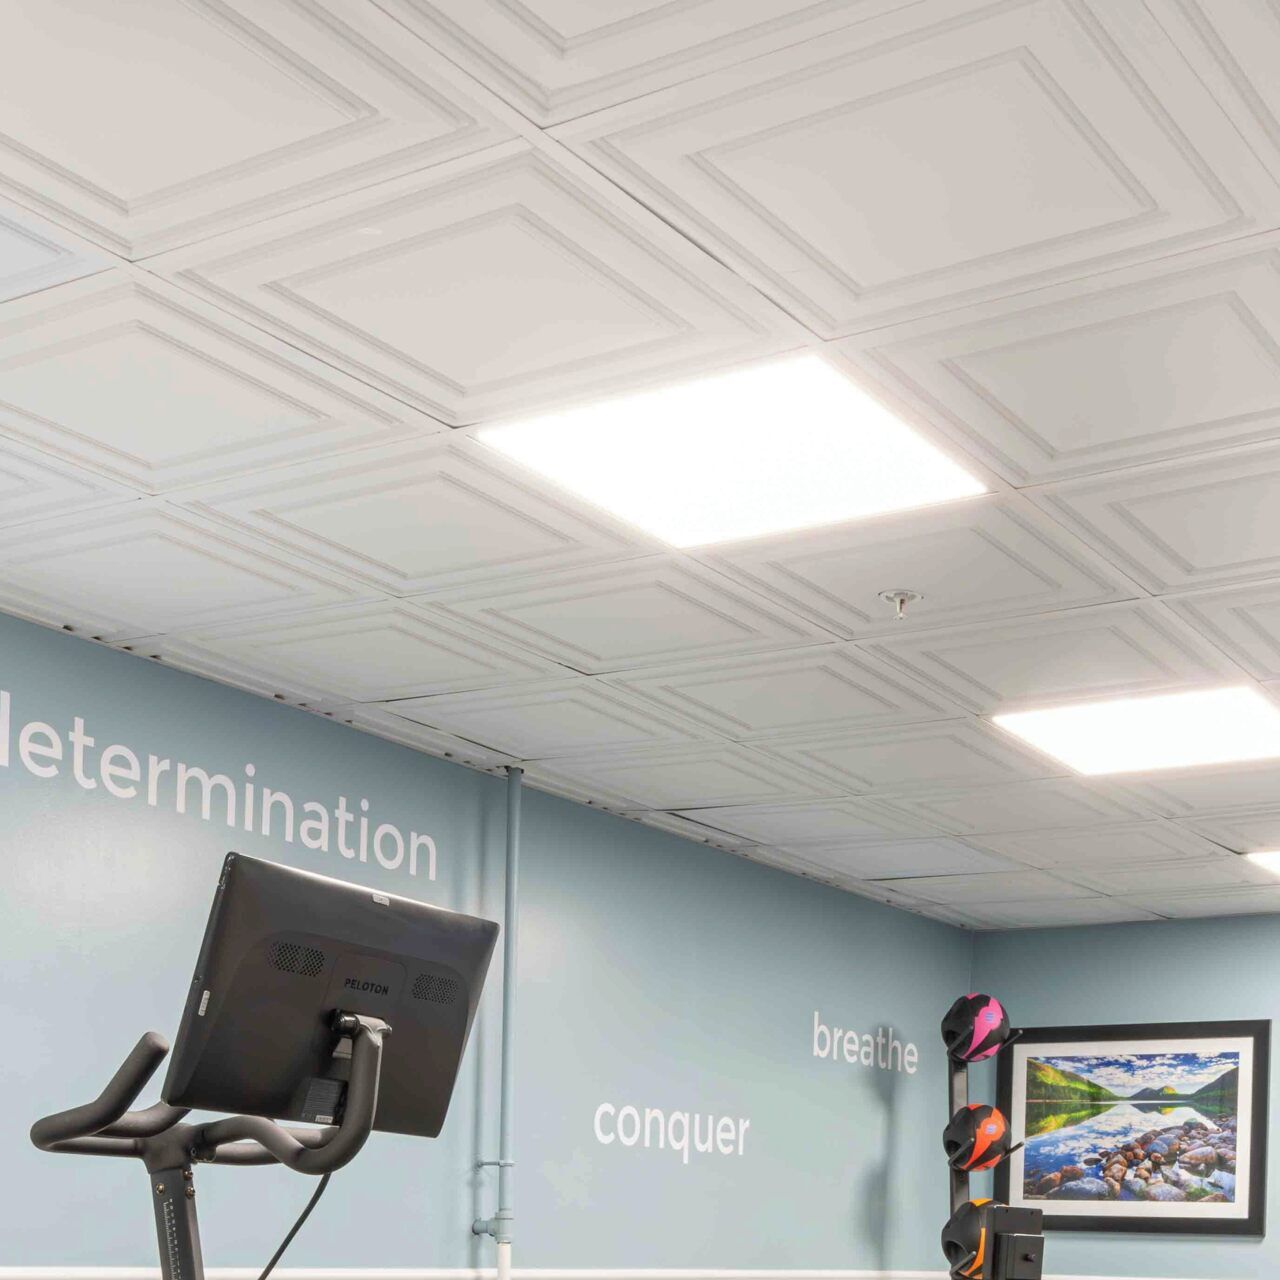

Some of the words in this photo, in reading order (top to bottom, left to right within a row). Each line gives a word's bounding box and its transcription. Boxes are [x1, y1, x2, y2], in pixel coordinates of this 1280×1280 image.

[344, 978, 390, 996] PELOTON
[813, 1011, 919, 1075] breathe
[594, 1102, 751, 1164] conquer
